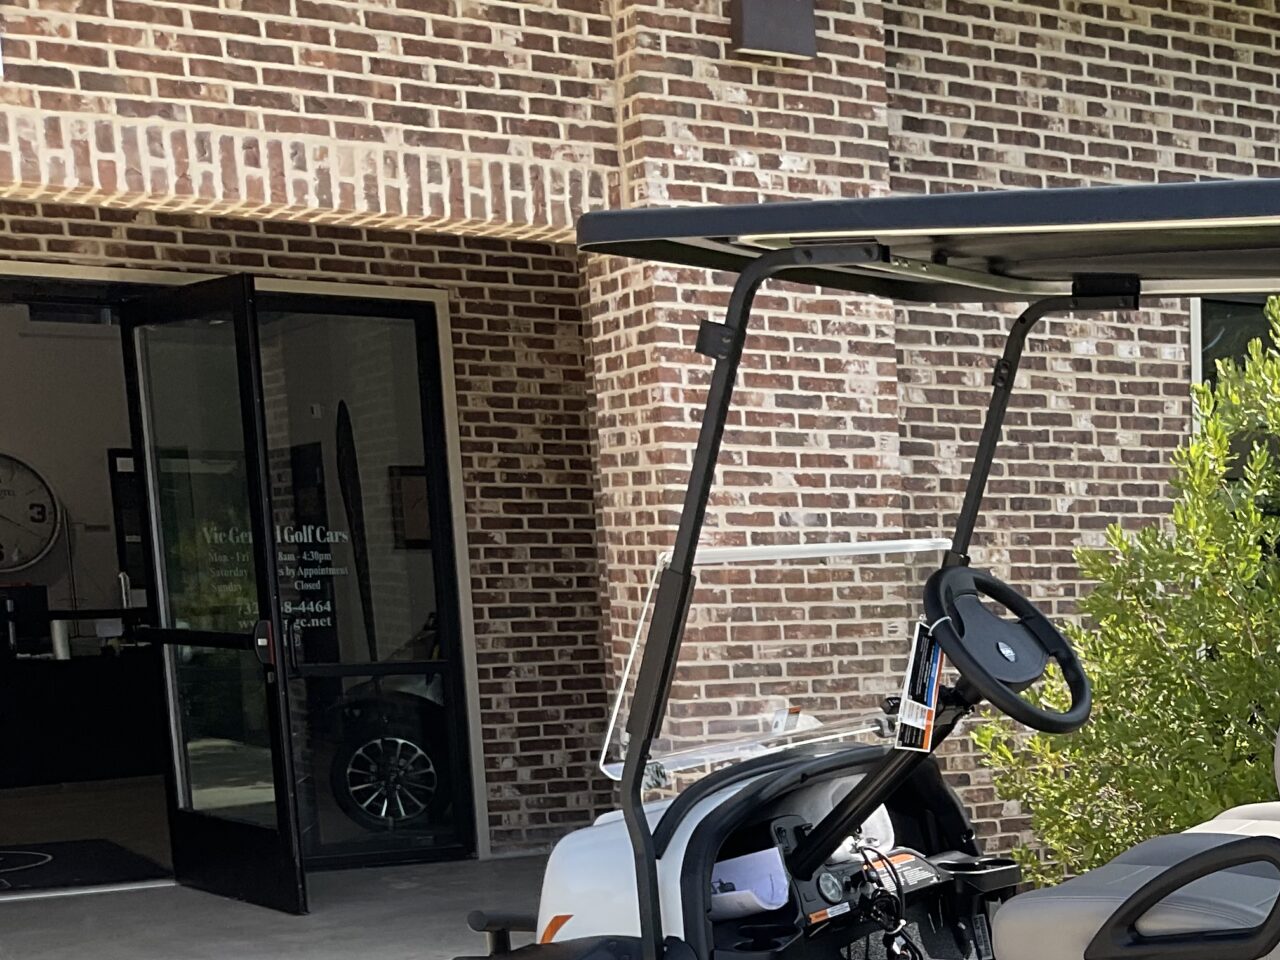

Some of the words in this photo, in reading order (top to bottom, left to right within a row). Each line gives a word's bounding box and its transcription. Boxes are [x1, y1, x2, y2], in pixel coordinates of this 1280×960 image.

[29, 503, 47, 523] 3
[202, 526, 226, 544] Vic
[284, 524, 314, 543] Golf
[315, 526, 349, 543] Cars
[208, 551, 229, 562] Mon
[278, 551, 296, 561] 8am
[302, 550, 332, 564] 4:30pm
[208, 567, 248, 579] Saturday
[285, 565, 296, 579] by
[297, 566, 349, 578] Appointment
[209, 581, 242, 594] Sunday
[294, 580, 321, 590] Closed
